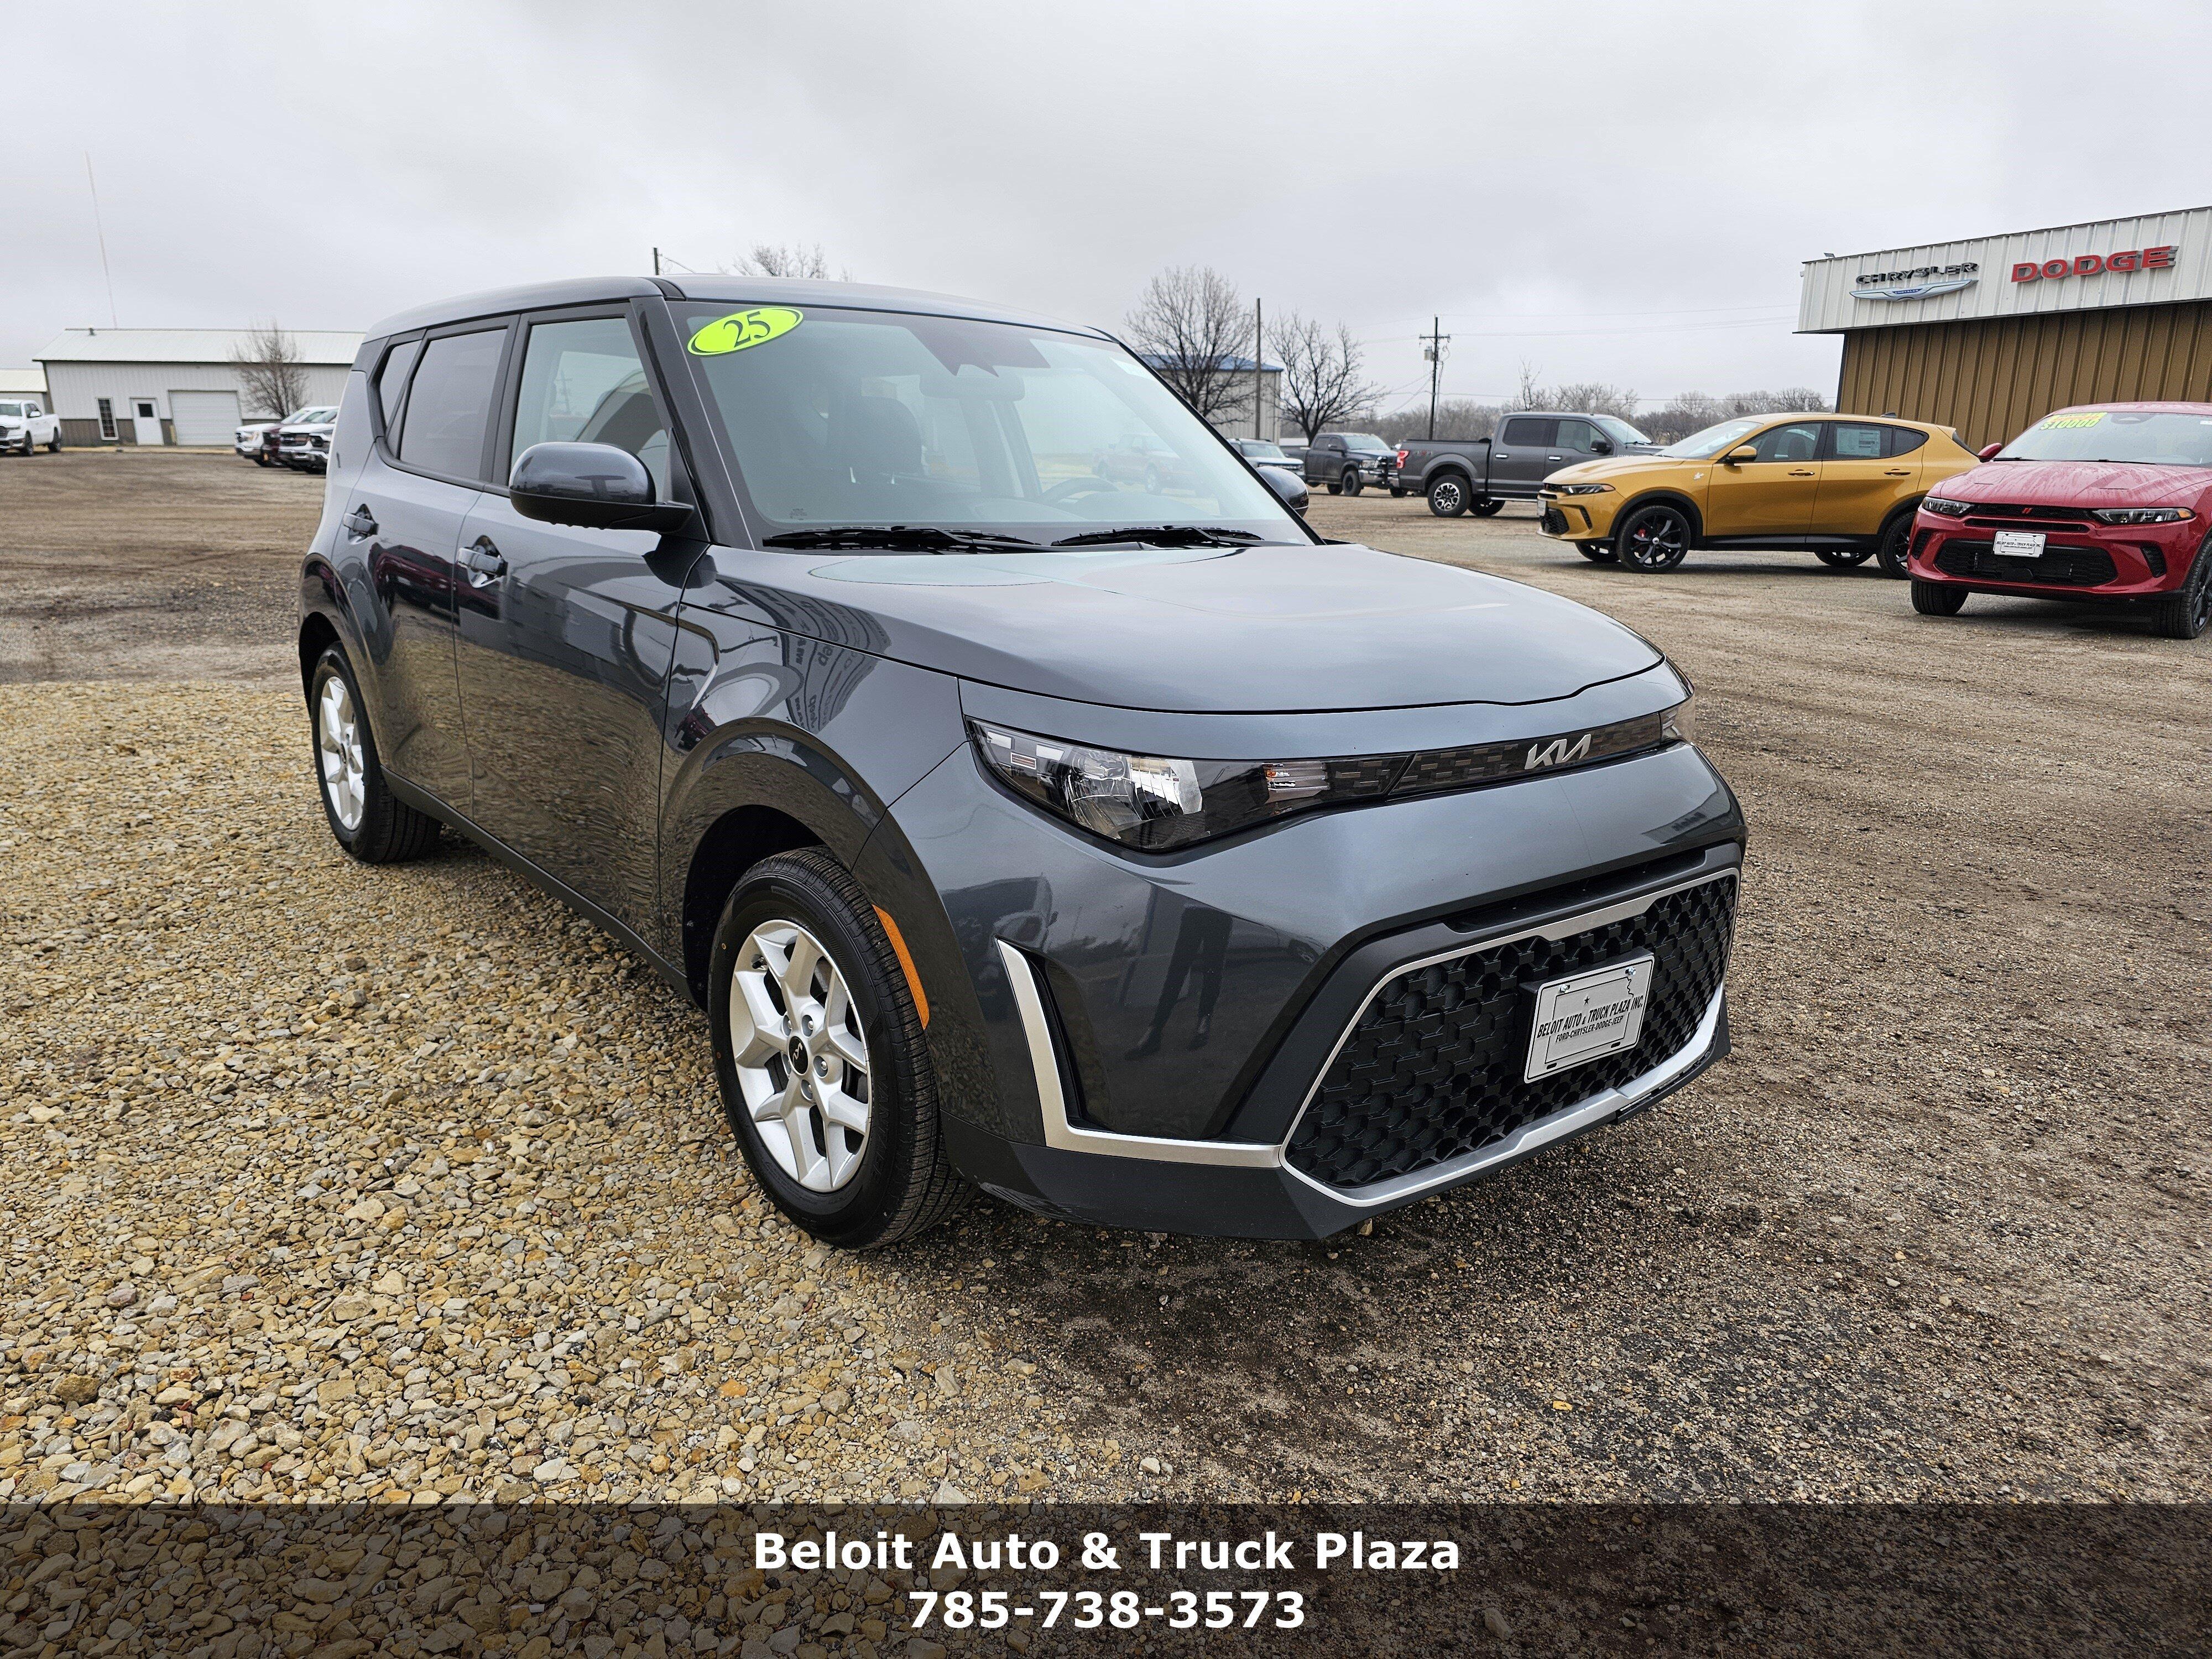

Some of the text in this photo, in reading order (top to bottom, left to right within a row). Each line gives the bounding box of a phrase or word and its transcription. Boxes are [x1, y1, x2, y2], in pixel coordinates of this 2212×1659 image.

[1856, 262, 1979, 285] CHRYSLER
[2011, 245, 2177, 283] DODGE
[723, 311, 771, 348] 25
[1524, 733, 1592, 770] KIA
[1536, 995, 1644, 1039] BELOIT AUTO & TRUCK PLAZA INC.
